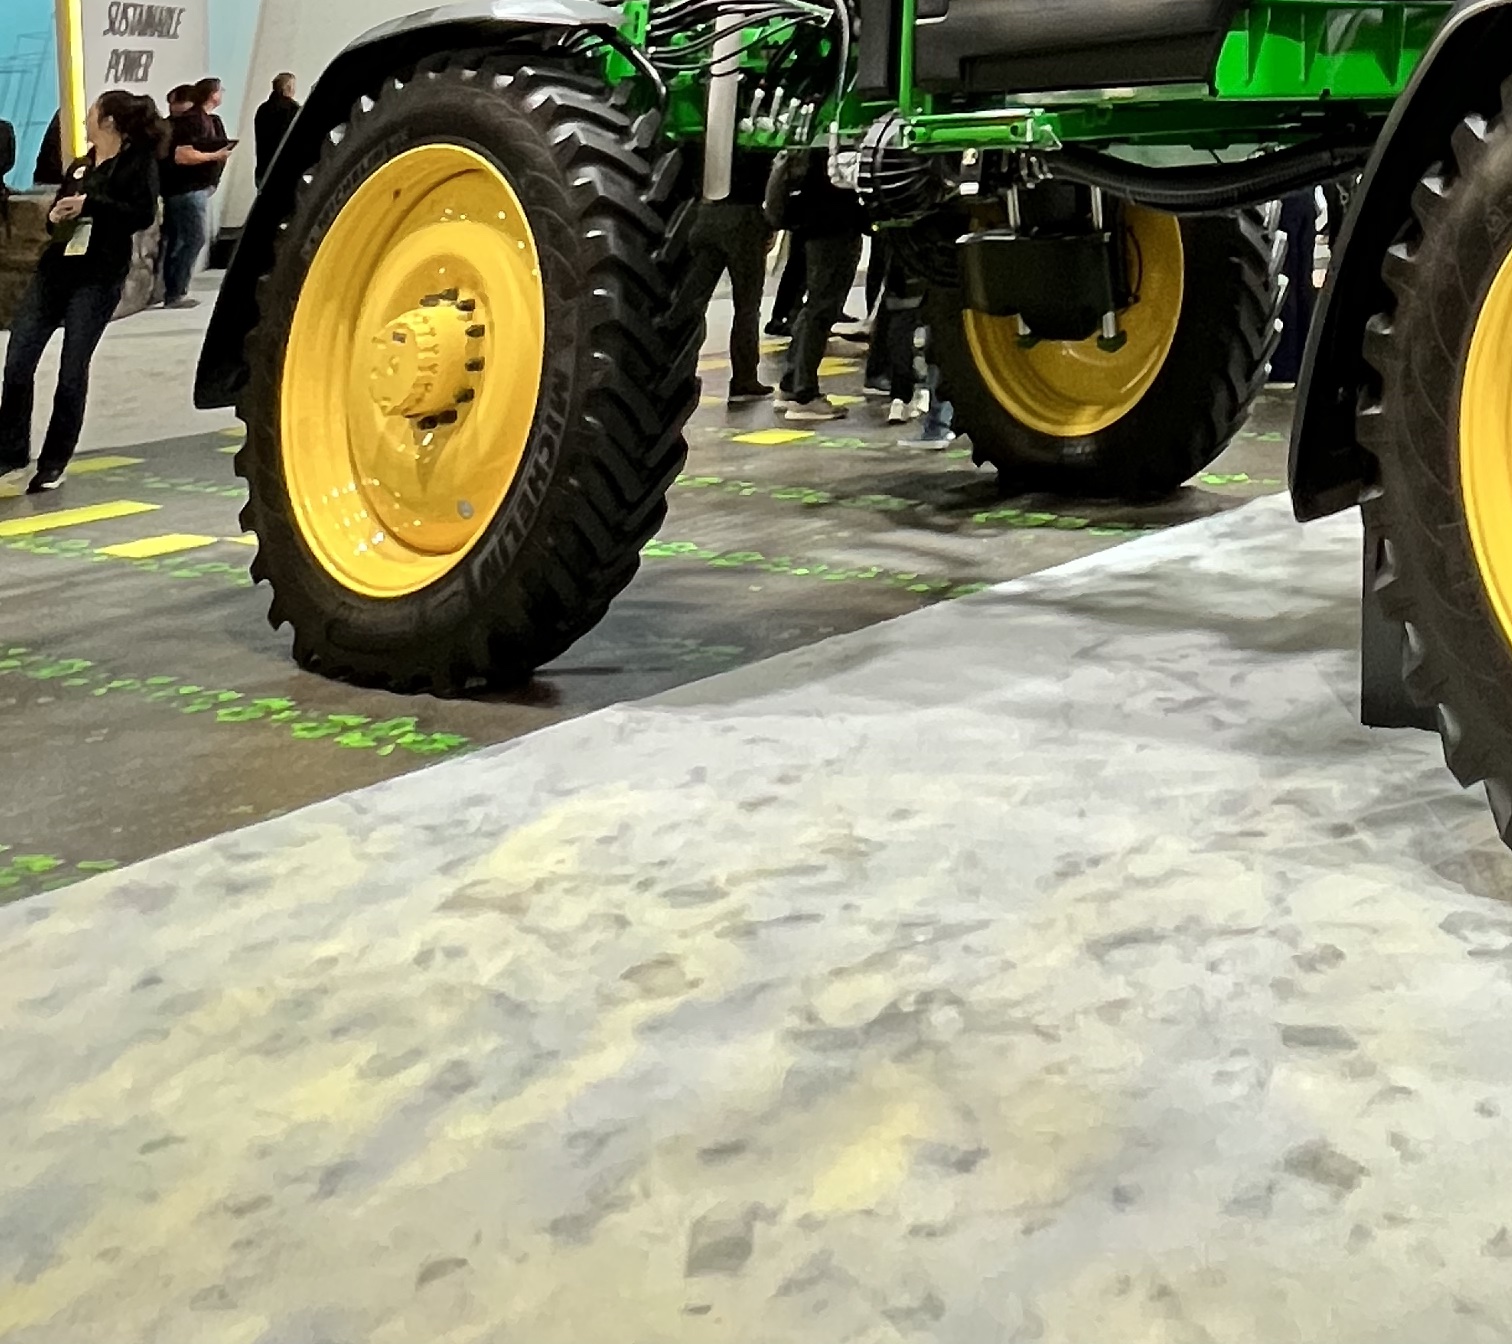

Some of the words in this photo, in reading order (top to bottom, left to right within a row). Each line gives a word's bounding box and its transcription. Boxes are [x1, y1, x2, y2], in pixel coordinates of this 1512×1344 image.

[102, 1, 186, 39] SUSTAINABLE
[104, 49, 154, 83] POWER
[473, 368, 570, 595] MICHELIN
